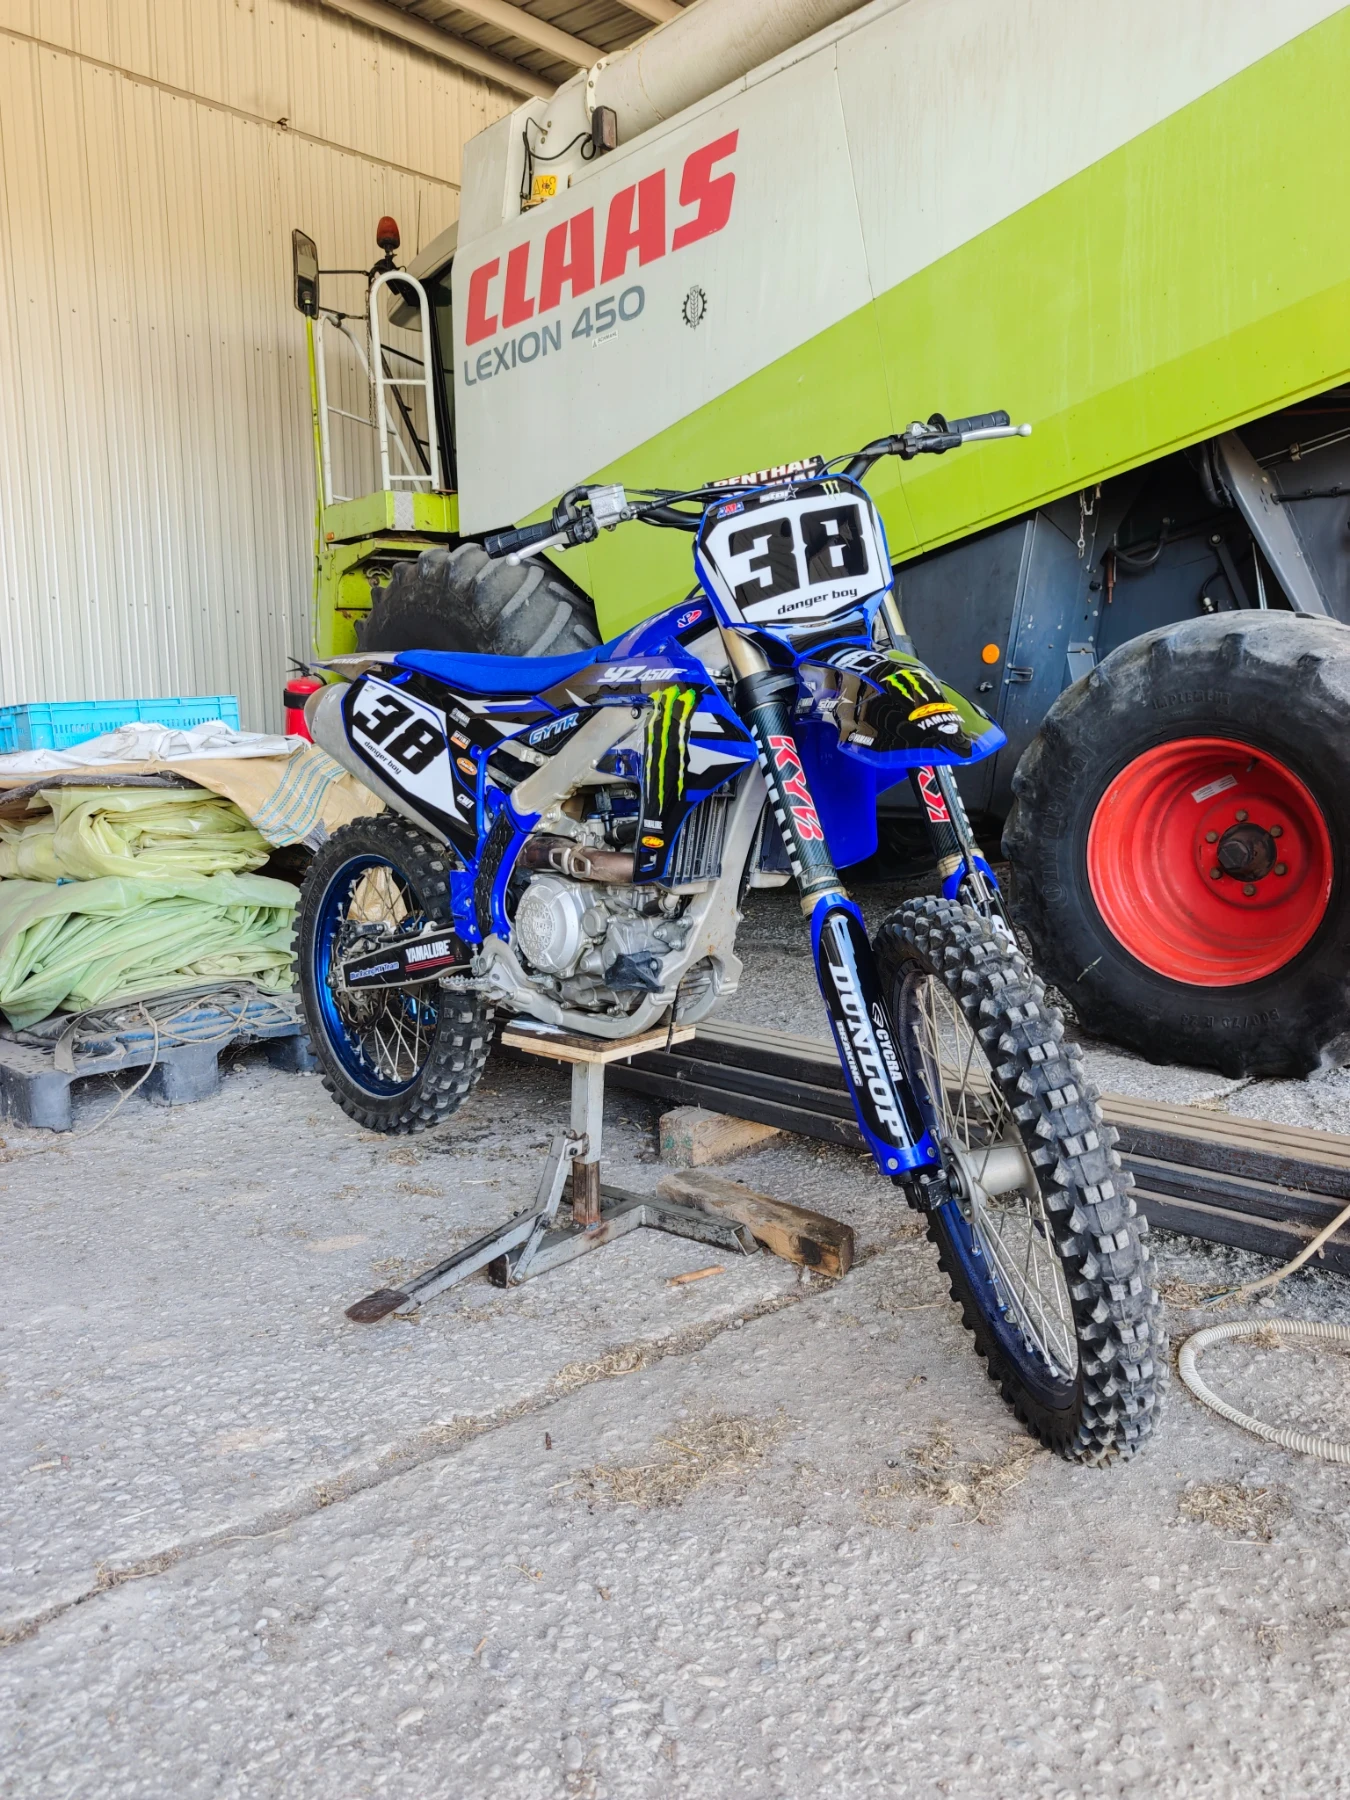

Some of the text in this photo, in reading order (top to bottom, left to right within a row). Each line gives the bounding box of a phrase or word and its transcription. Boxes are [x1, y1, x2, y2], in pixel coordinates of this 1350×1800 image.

[465, 128, 740, 346] CLAAS
[463, 285, 646, 386] LEXION 450
[728, 503, 869, 610] 38
[777, 588, 859, 616] danger boy
[597, 665, 689, 683] YZ450F
[352, 694, 449, 775] 38
[529, 712, 579, 745] GYTR
[917, 713, 966, 731] YAMAHA
[364, 740, 402, 776] danger boy
[767, 735, 825, 841] KYB
[405, 939, 451, 964] YAMALUBE
[828, 962, 904, 1138] DUNLOP
[835, 1020, 864, 1087] BRAKING
[875, 1028, 904, 1082] CYCRA
